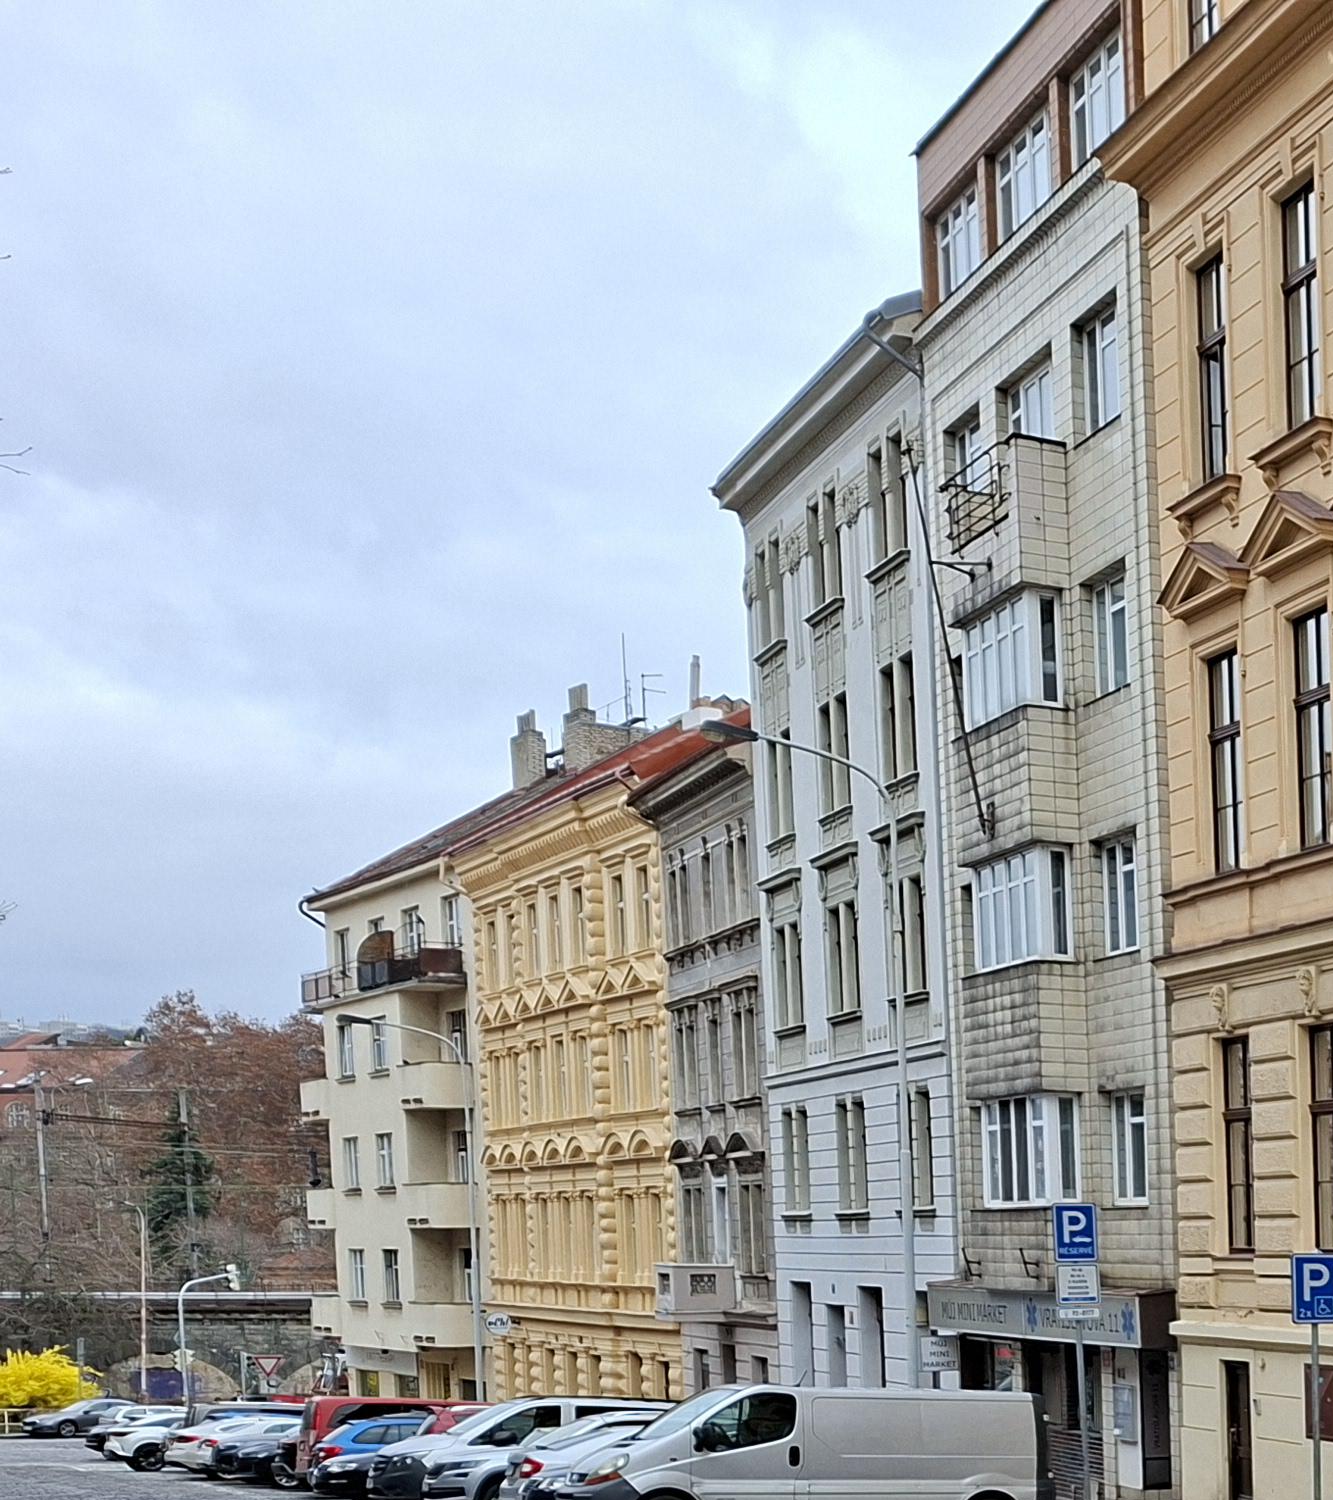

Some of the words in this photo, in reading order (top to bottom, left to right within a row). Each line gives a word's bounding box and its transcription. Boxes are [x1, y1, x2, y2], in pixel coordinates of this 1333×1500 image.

[1062, 1211, 1087, 1244] P
[1059, 1247, 1094, 1255] RÉSERVÉ
[1303, 1263, 1330, 1301] P
[977, 1303, 1008, 1325] MARKET
[1108, 1313, 1119, 1333] 11
[1300, 1308, 1312, 1318] 2x
[922, 1360, 957, 1368] MARKET
